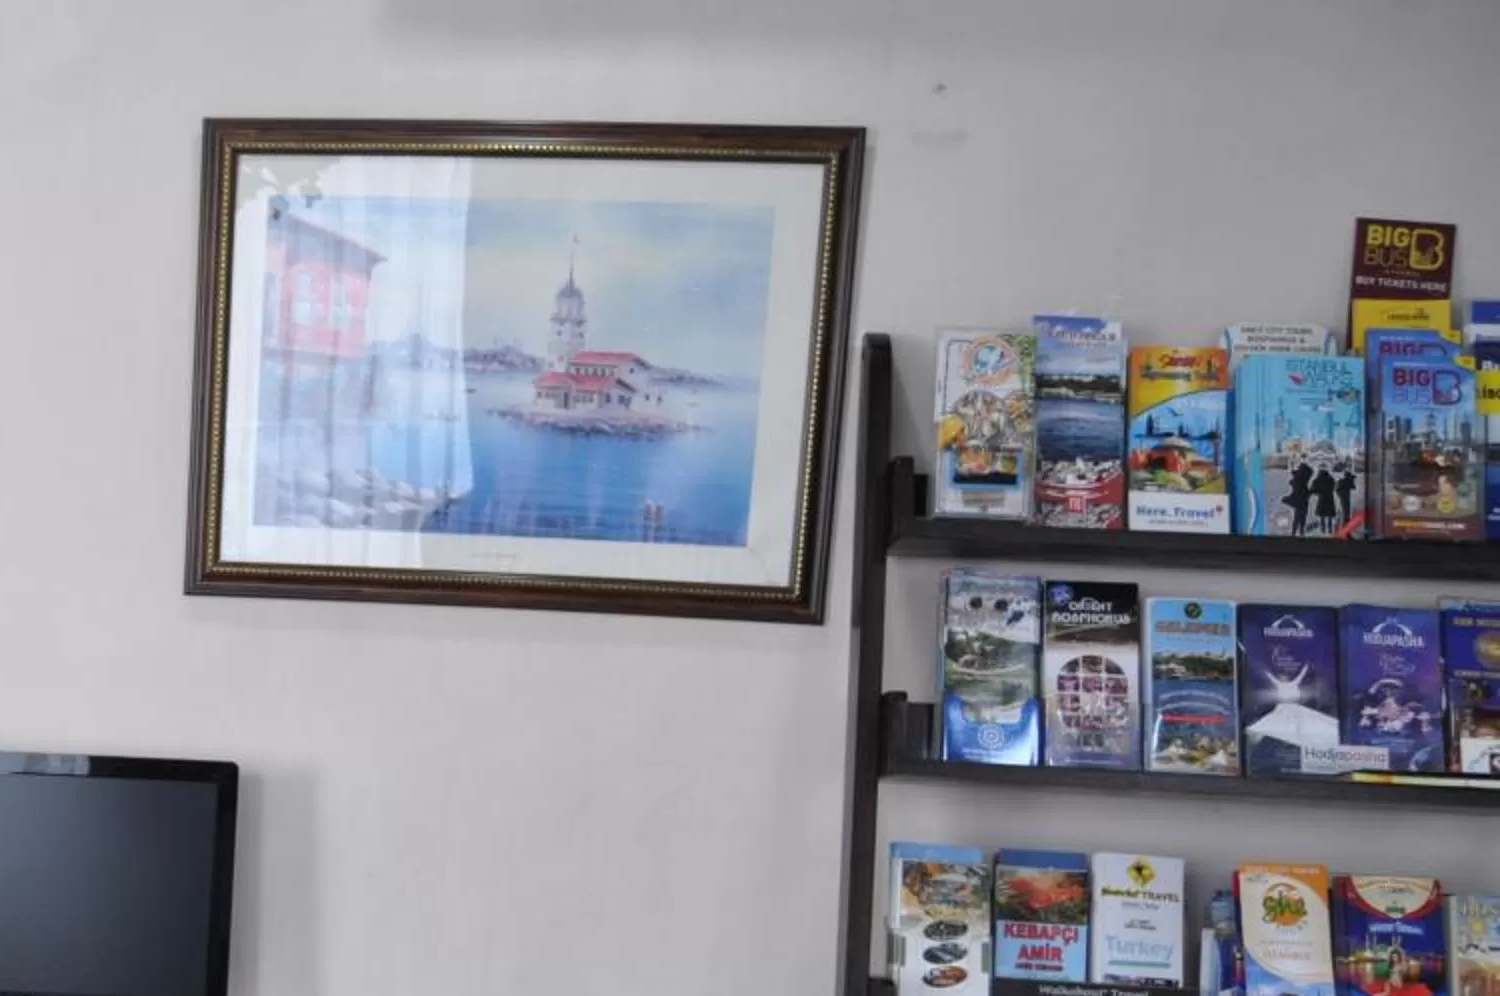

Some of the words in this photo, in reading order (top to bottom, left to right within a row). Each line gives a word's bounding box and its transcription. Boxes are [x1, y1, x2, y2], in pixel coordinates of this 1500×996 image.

[1366, 224, 1410, 247] BIG
[1363, 246, 1407, 268] BUS
[1377, 277, 1418, 290] TICKETS
[1393, 367, 1431, 386] BIG
[1004, 922, 1079, 946] KEBAPÇI
[1018, 943, 1062, 961] AMİR
